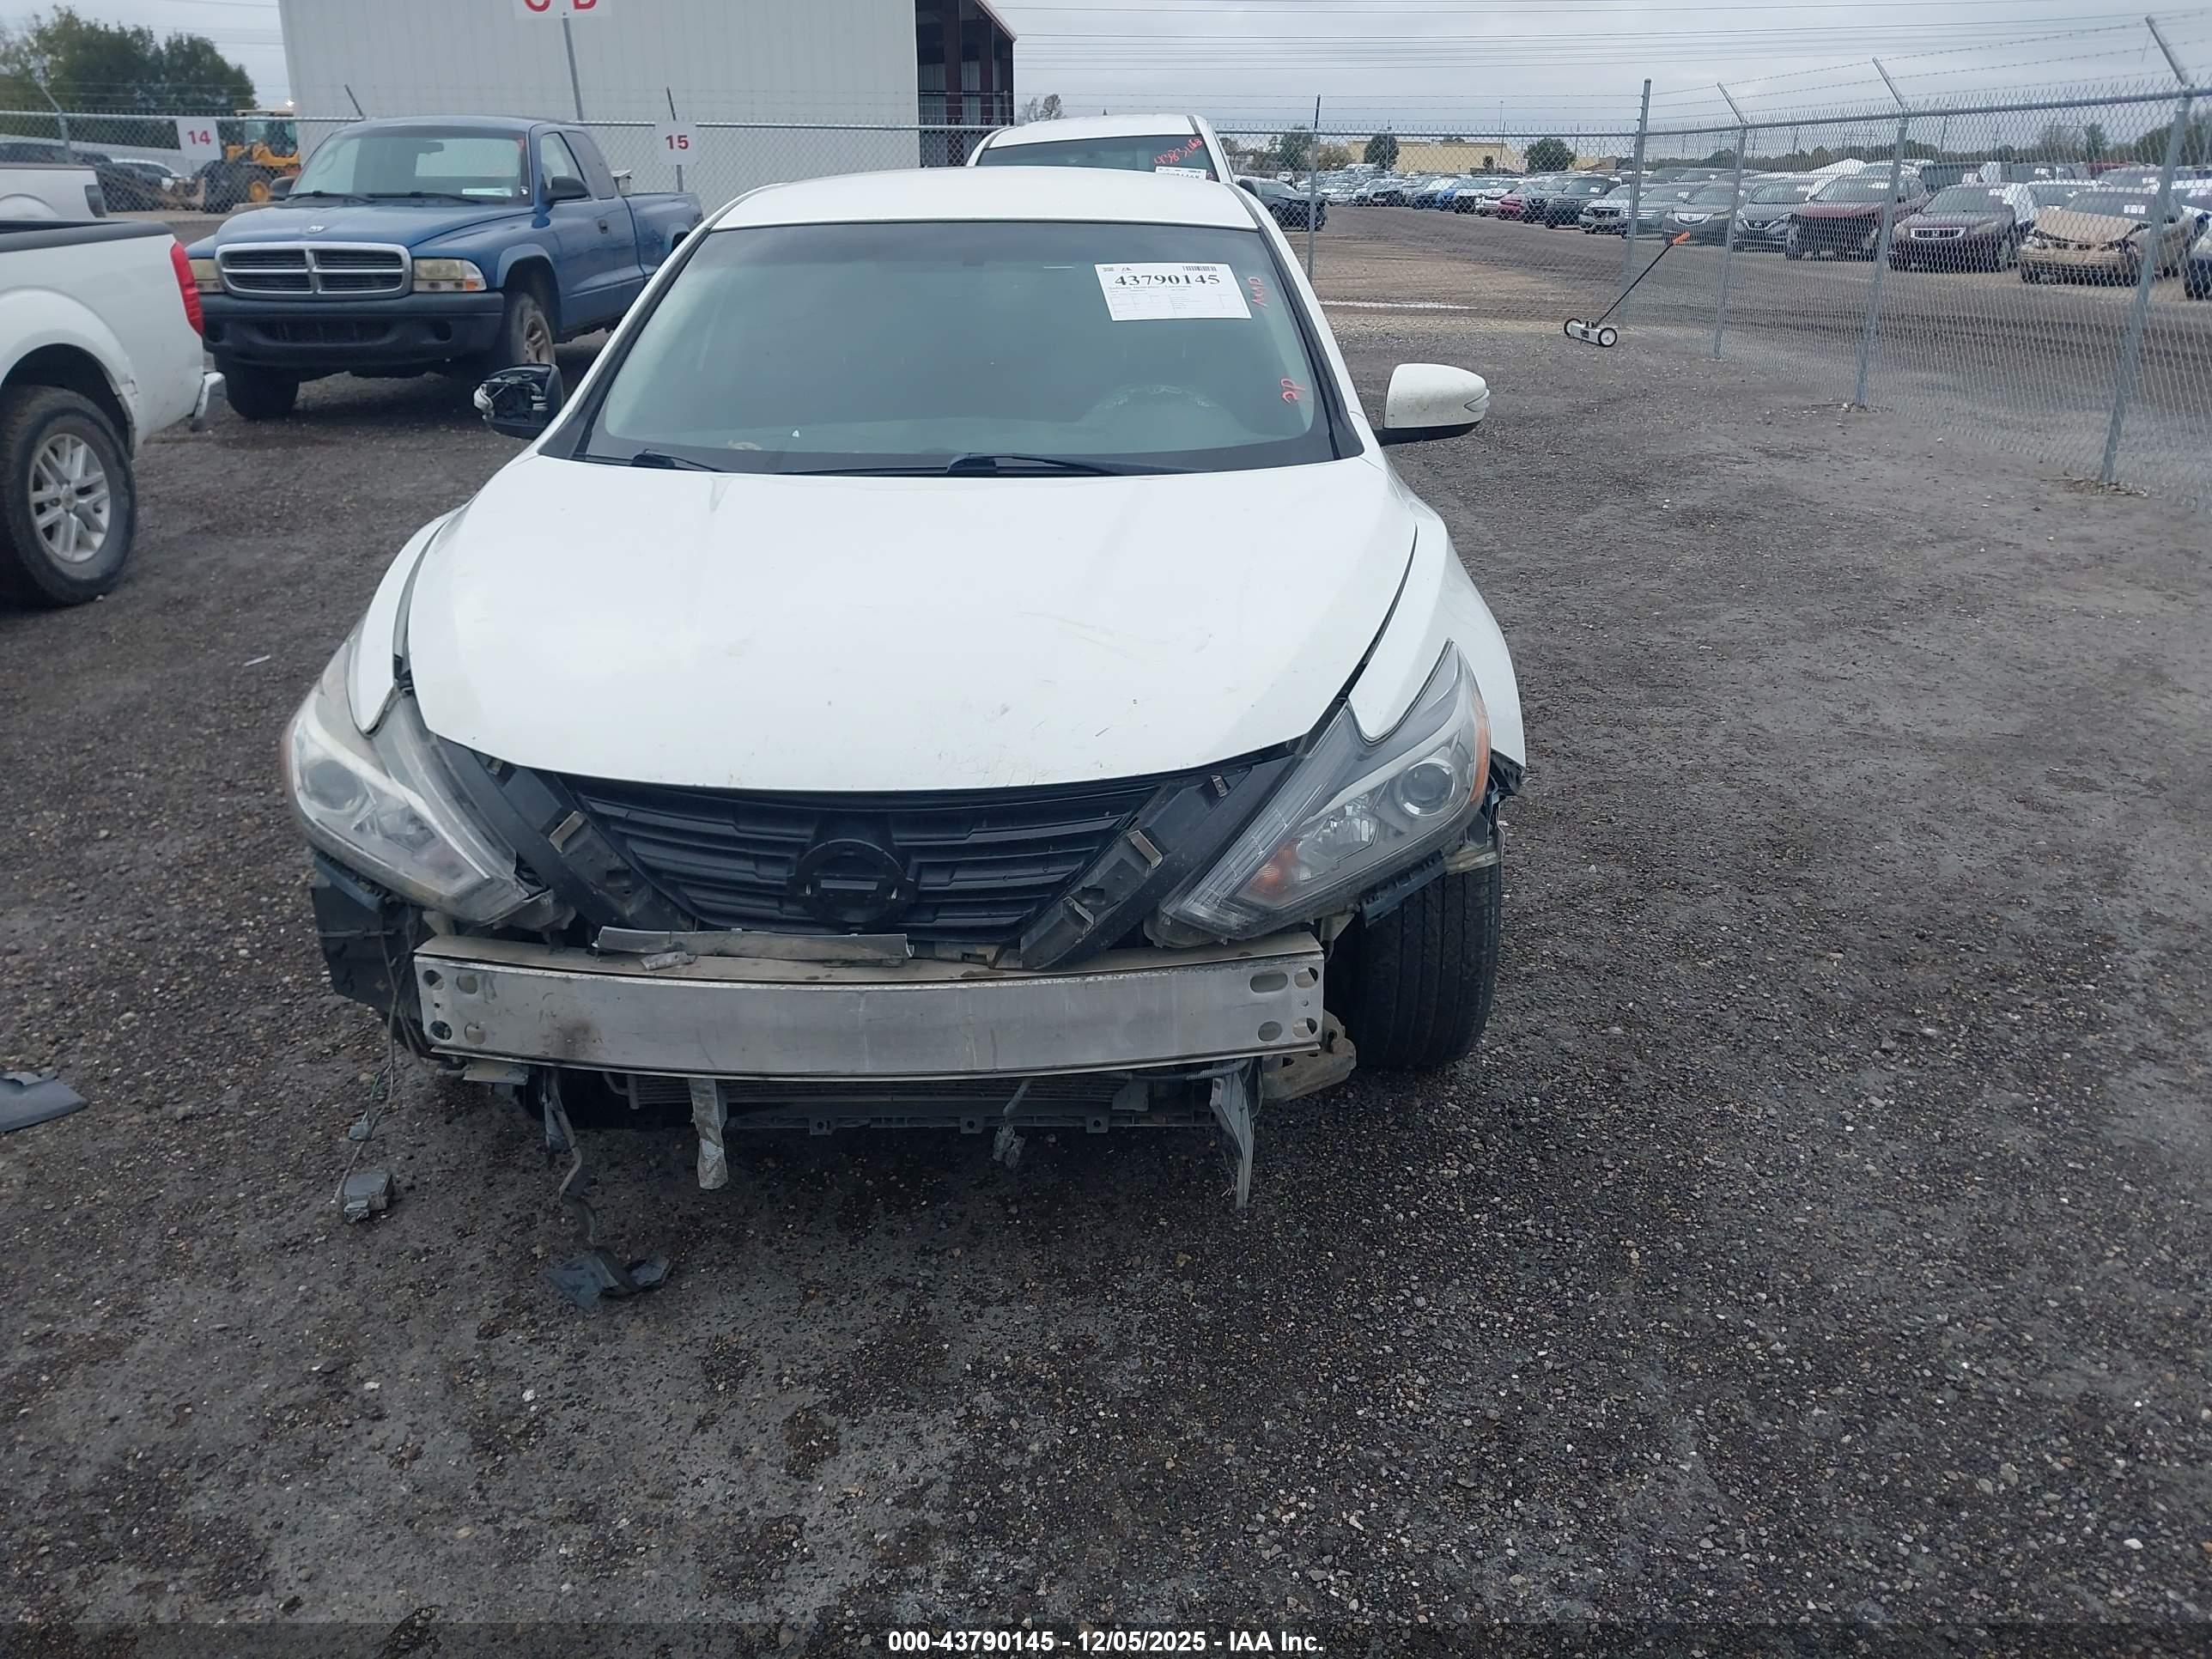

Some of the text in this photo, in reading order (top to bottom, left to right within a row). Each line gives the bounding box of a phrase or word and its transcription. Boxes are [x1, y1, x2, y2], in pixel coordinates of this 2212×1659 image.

[187, 130, 211, 144] 14
[665, 135, 689, 149] 15
[1115, 274, 1220, 285] 43790145
